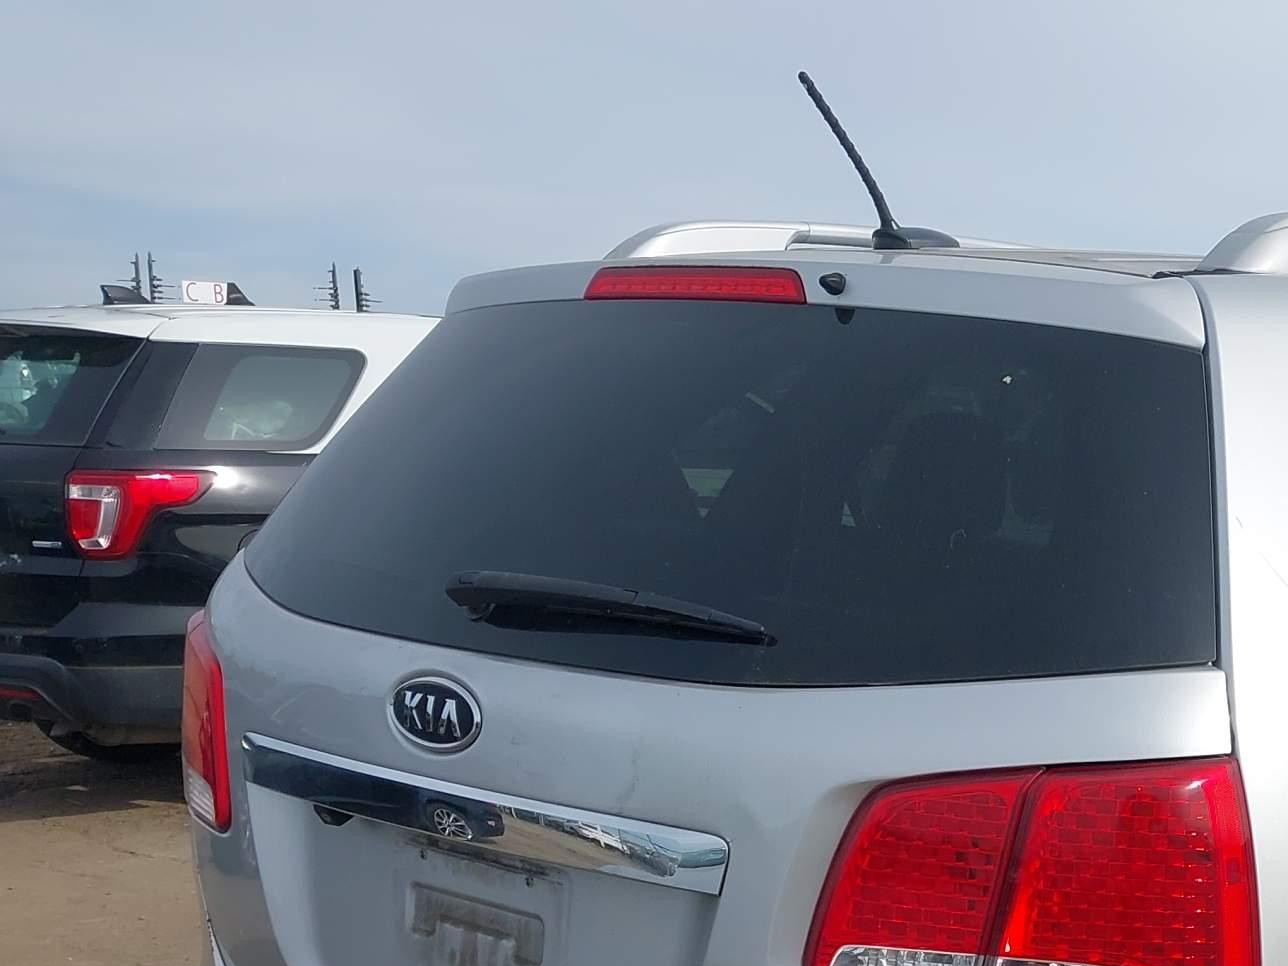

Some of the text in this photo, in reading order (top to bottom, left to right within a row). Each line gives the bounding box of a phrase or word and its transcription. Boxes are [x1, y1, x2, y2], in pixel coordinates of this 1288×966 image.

[186, 282, 225, 304] C B
[403, 690, 461, 738] KIA
